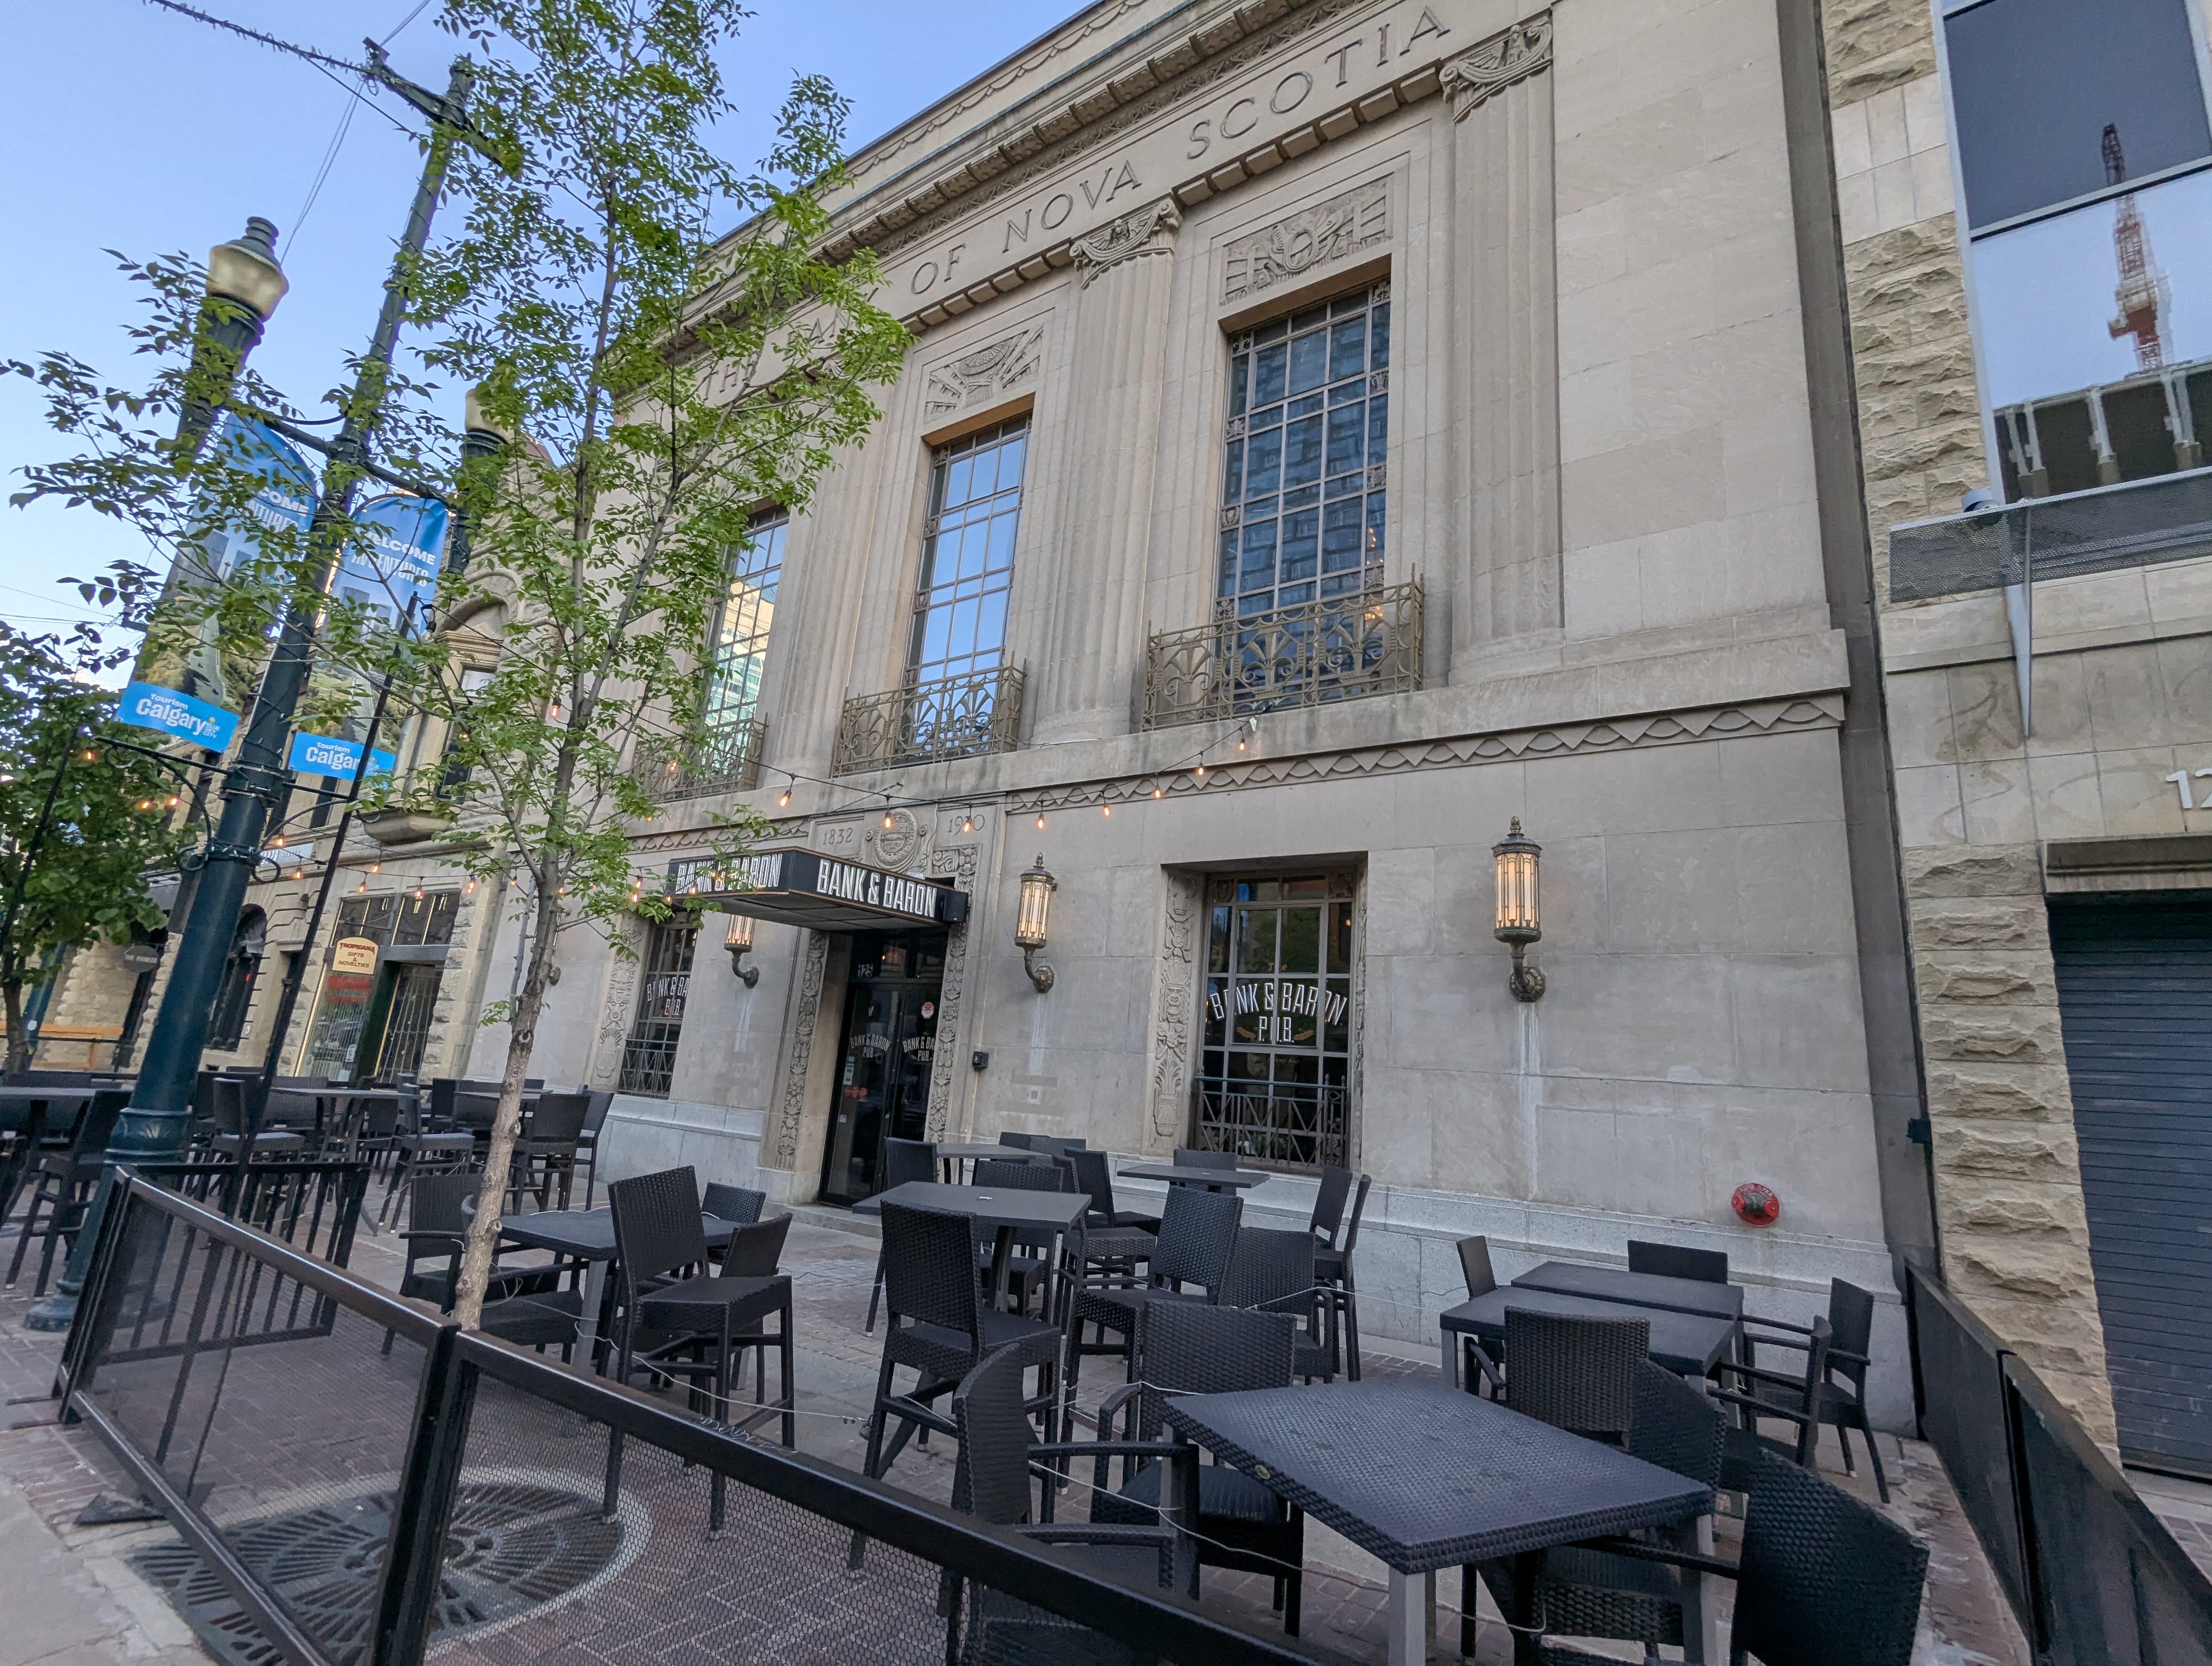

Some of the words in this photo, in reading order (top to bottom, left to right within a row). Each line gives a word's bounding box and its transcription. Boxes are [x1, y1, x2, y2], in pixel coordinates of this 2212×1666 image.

[911, 243, 966, 294] OF
[1002, 159, 1142, 253] NOVA
[1187, 5, 1451, 159] SCOTIA
[150, 693, 188, 709] Tourism
[136, 699, 207, 735] Calgary
[317, 742, 350, 753] Tourism
[305, 746, 361, 771] Calgar
[822, 827, 853, 845] 1832
[816, 858, 867, 902] BANK
[867, 872, 881, 905] &
[883, 875, 937, 918] BARON
[339, 943, 375, 955] TROPICANA
[338, 960, 370, 968] NOVELTIES
[1268, 962, 1288, 971] Te
[670, 977, 677, 995] &
[1264, 982, 1274, 1011] &
[850, 1034, 866, 1049] BANK
[870, 1034, 891, 1052] BARON
[902, 1037, 920, 1053] BANK
